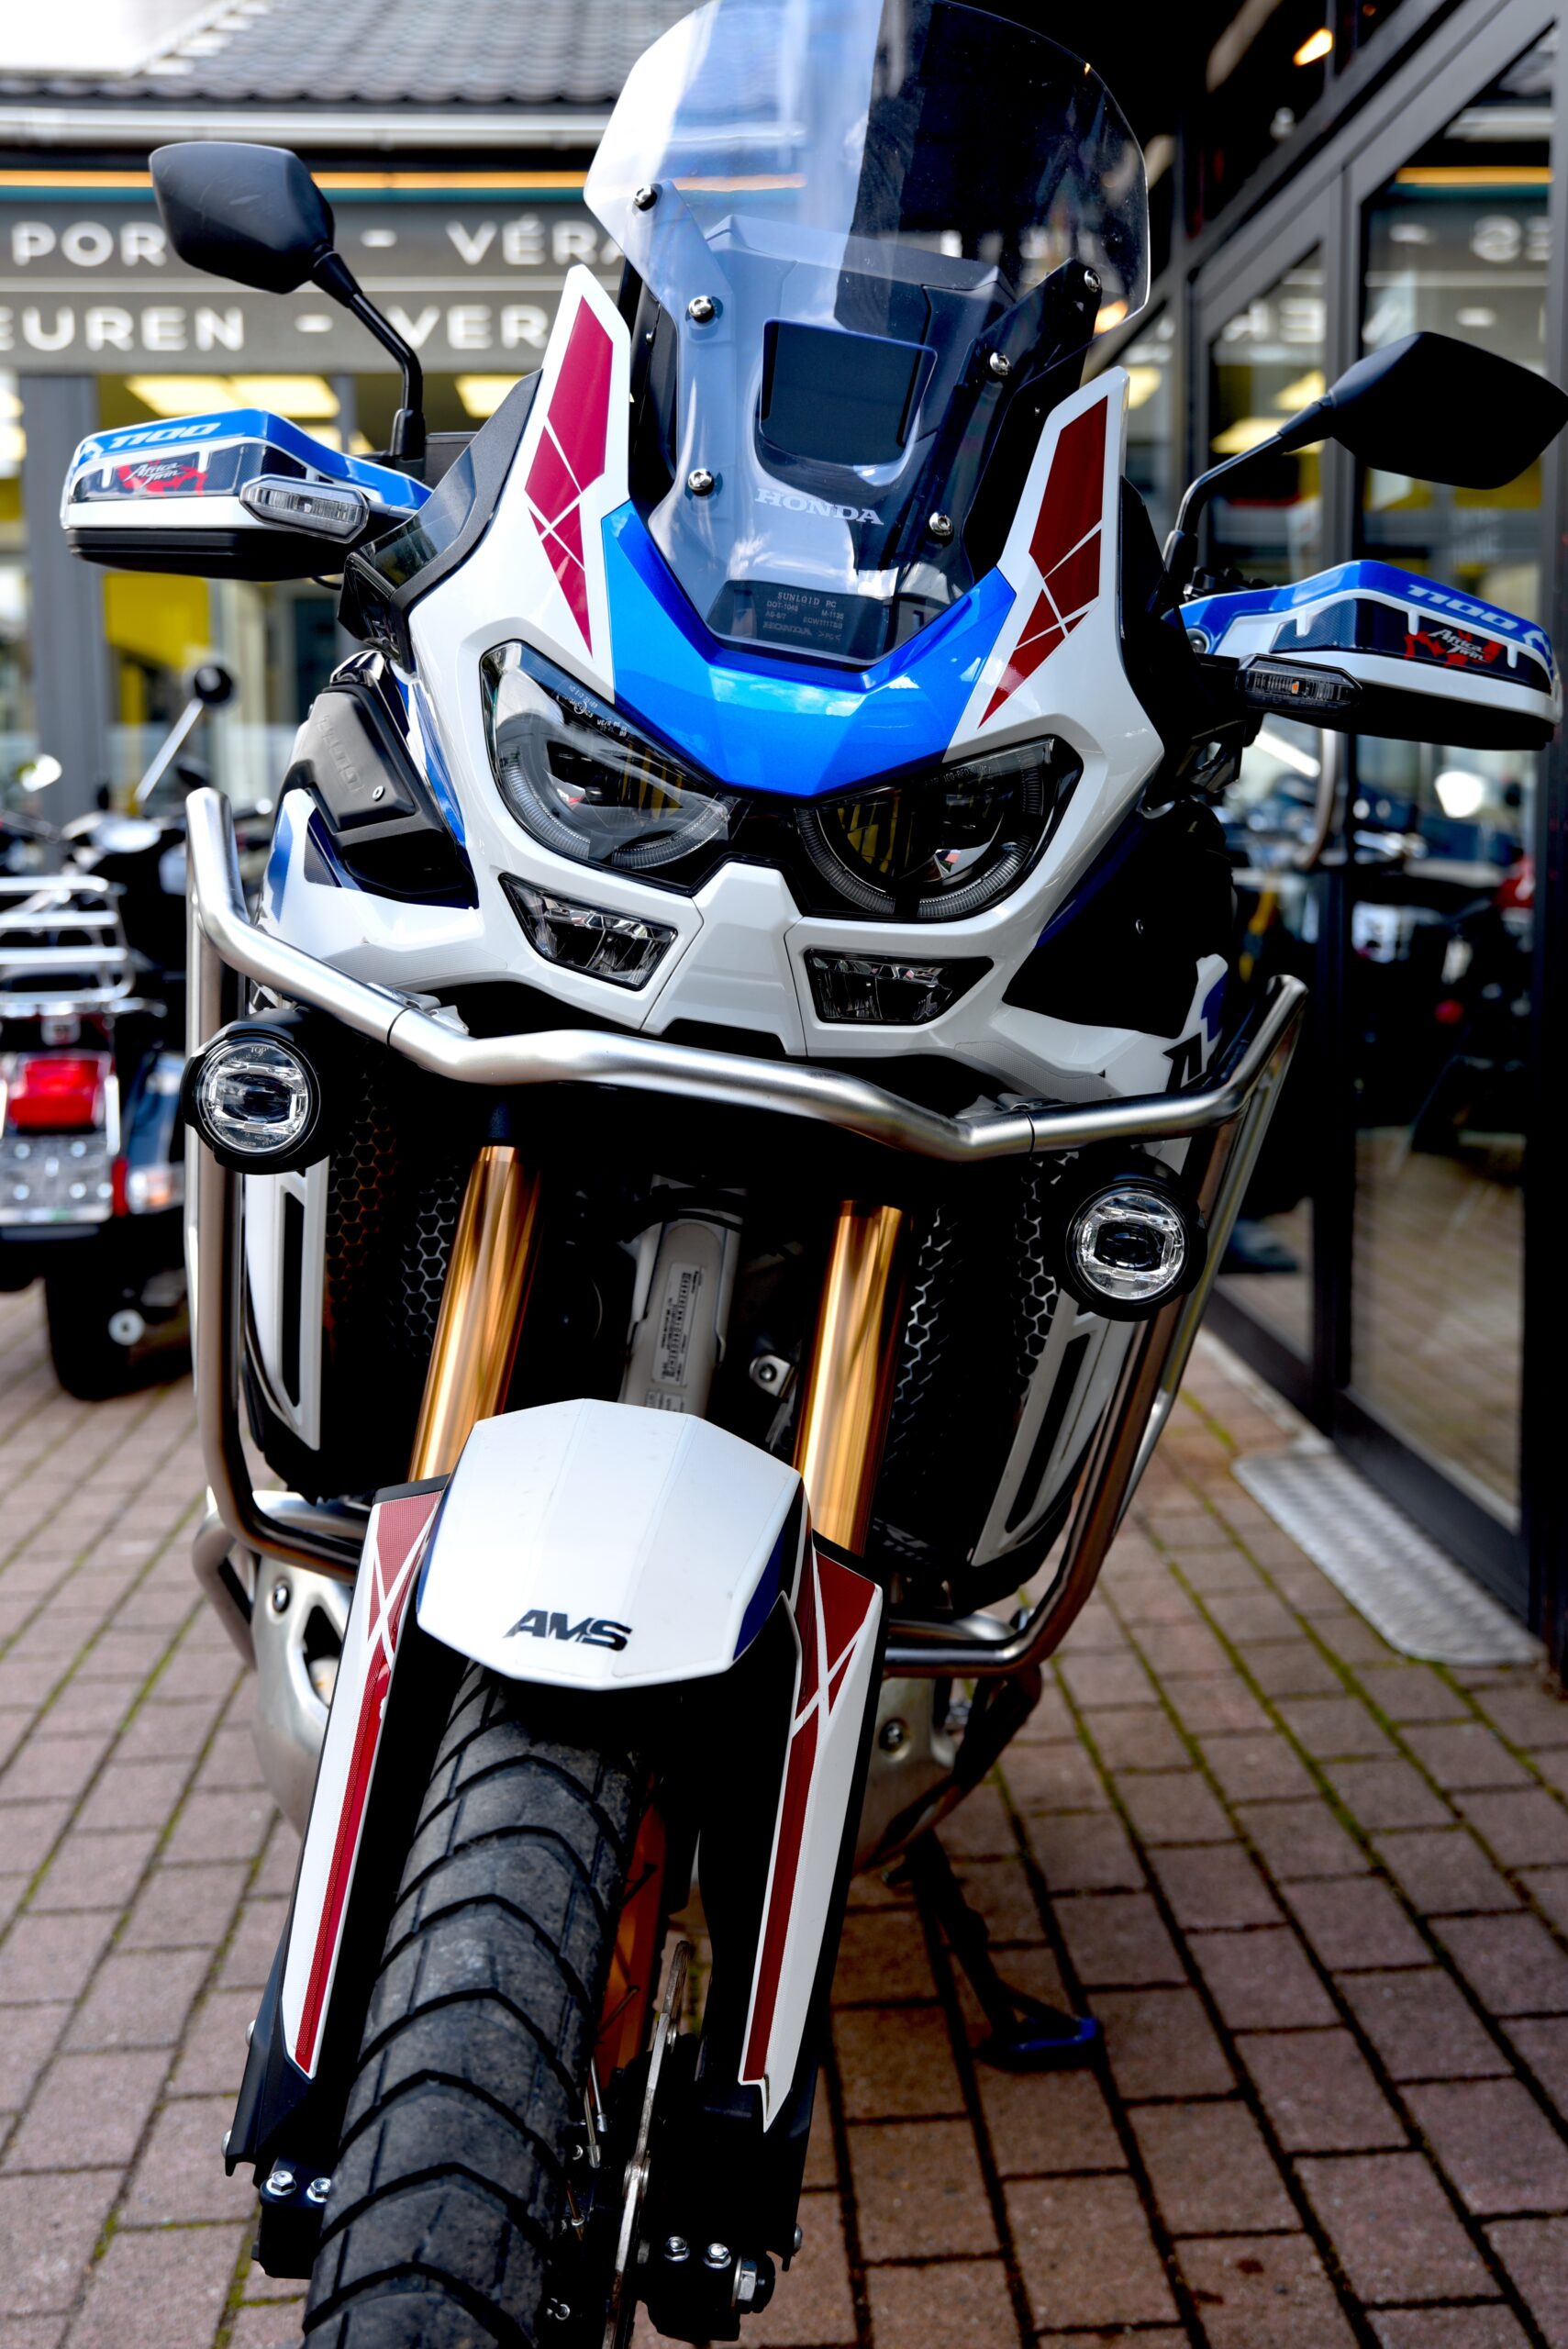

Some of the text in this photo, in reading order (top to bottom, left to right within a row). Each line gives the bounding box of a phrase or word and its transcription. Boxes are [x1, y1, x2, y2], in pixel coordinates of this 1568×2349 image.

[12, 221, 167, 267] POR
[385, 305, 549, 350] VER
[108, 422, 221, 450] 1100
[123, 462, 183, 482] Africa
[138, 469, 184, 488] Twin
[755, 488, 884, 526] HONDA
[778, 592, 820, 606] SUNLOID
[1407, 584, 1518, 630] 1100
[1428, 629, 1485, 654] Africa
[1447, 644, 1491, 663] Twin
[502, 1609, 633, 1652] AMS
